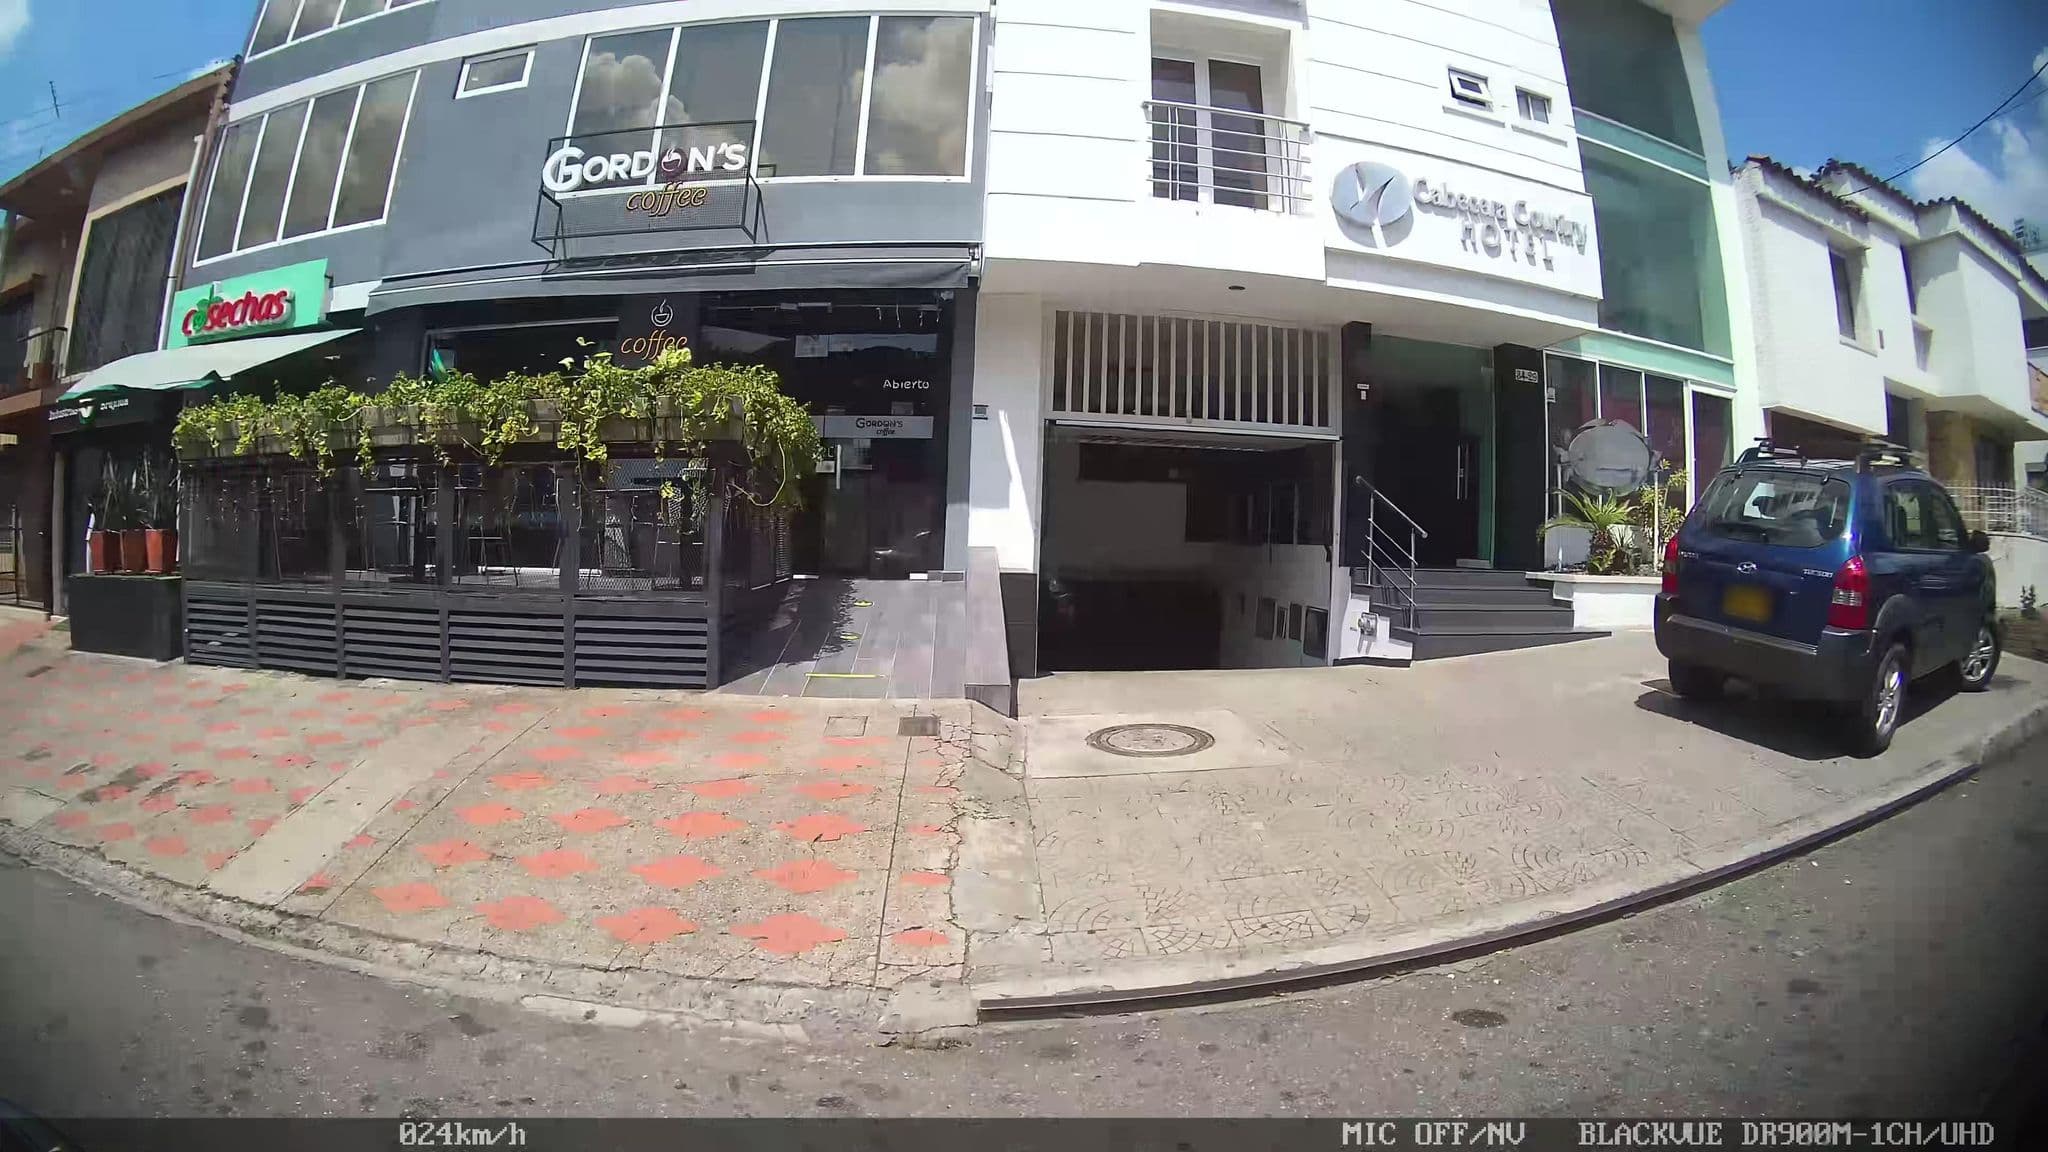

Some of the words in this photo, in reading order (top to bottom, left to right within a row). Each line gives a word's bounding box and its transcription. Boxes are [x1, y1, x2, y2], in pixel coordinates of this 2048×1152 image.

[542, 143, 747, 192] GORDON'S
[625, 181, 708, 217] coffee
[1413, 178, 1508, 222] Cabecera
[1461, 222, 1553, 266] HOTEL
[620, 329, 688, 360] coffee
[882, 378, 930, 389] Abierto
[855, 417, 903, 429] GORDON'S
